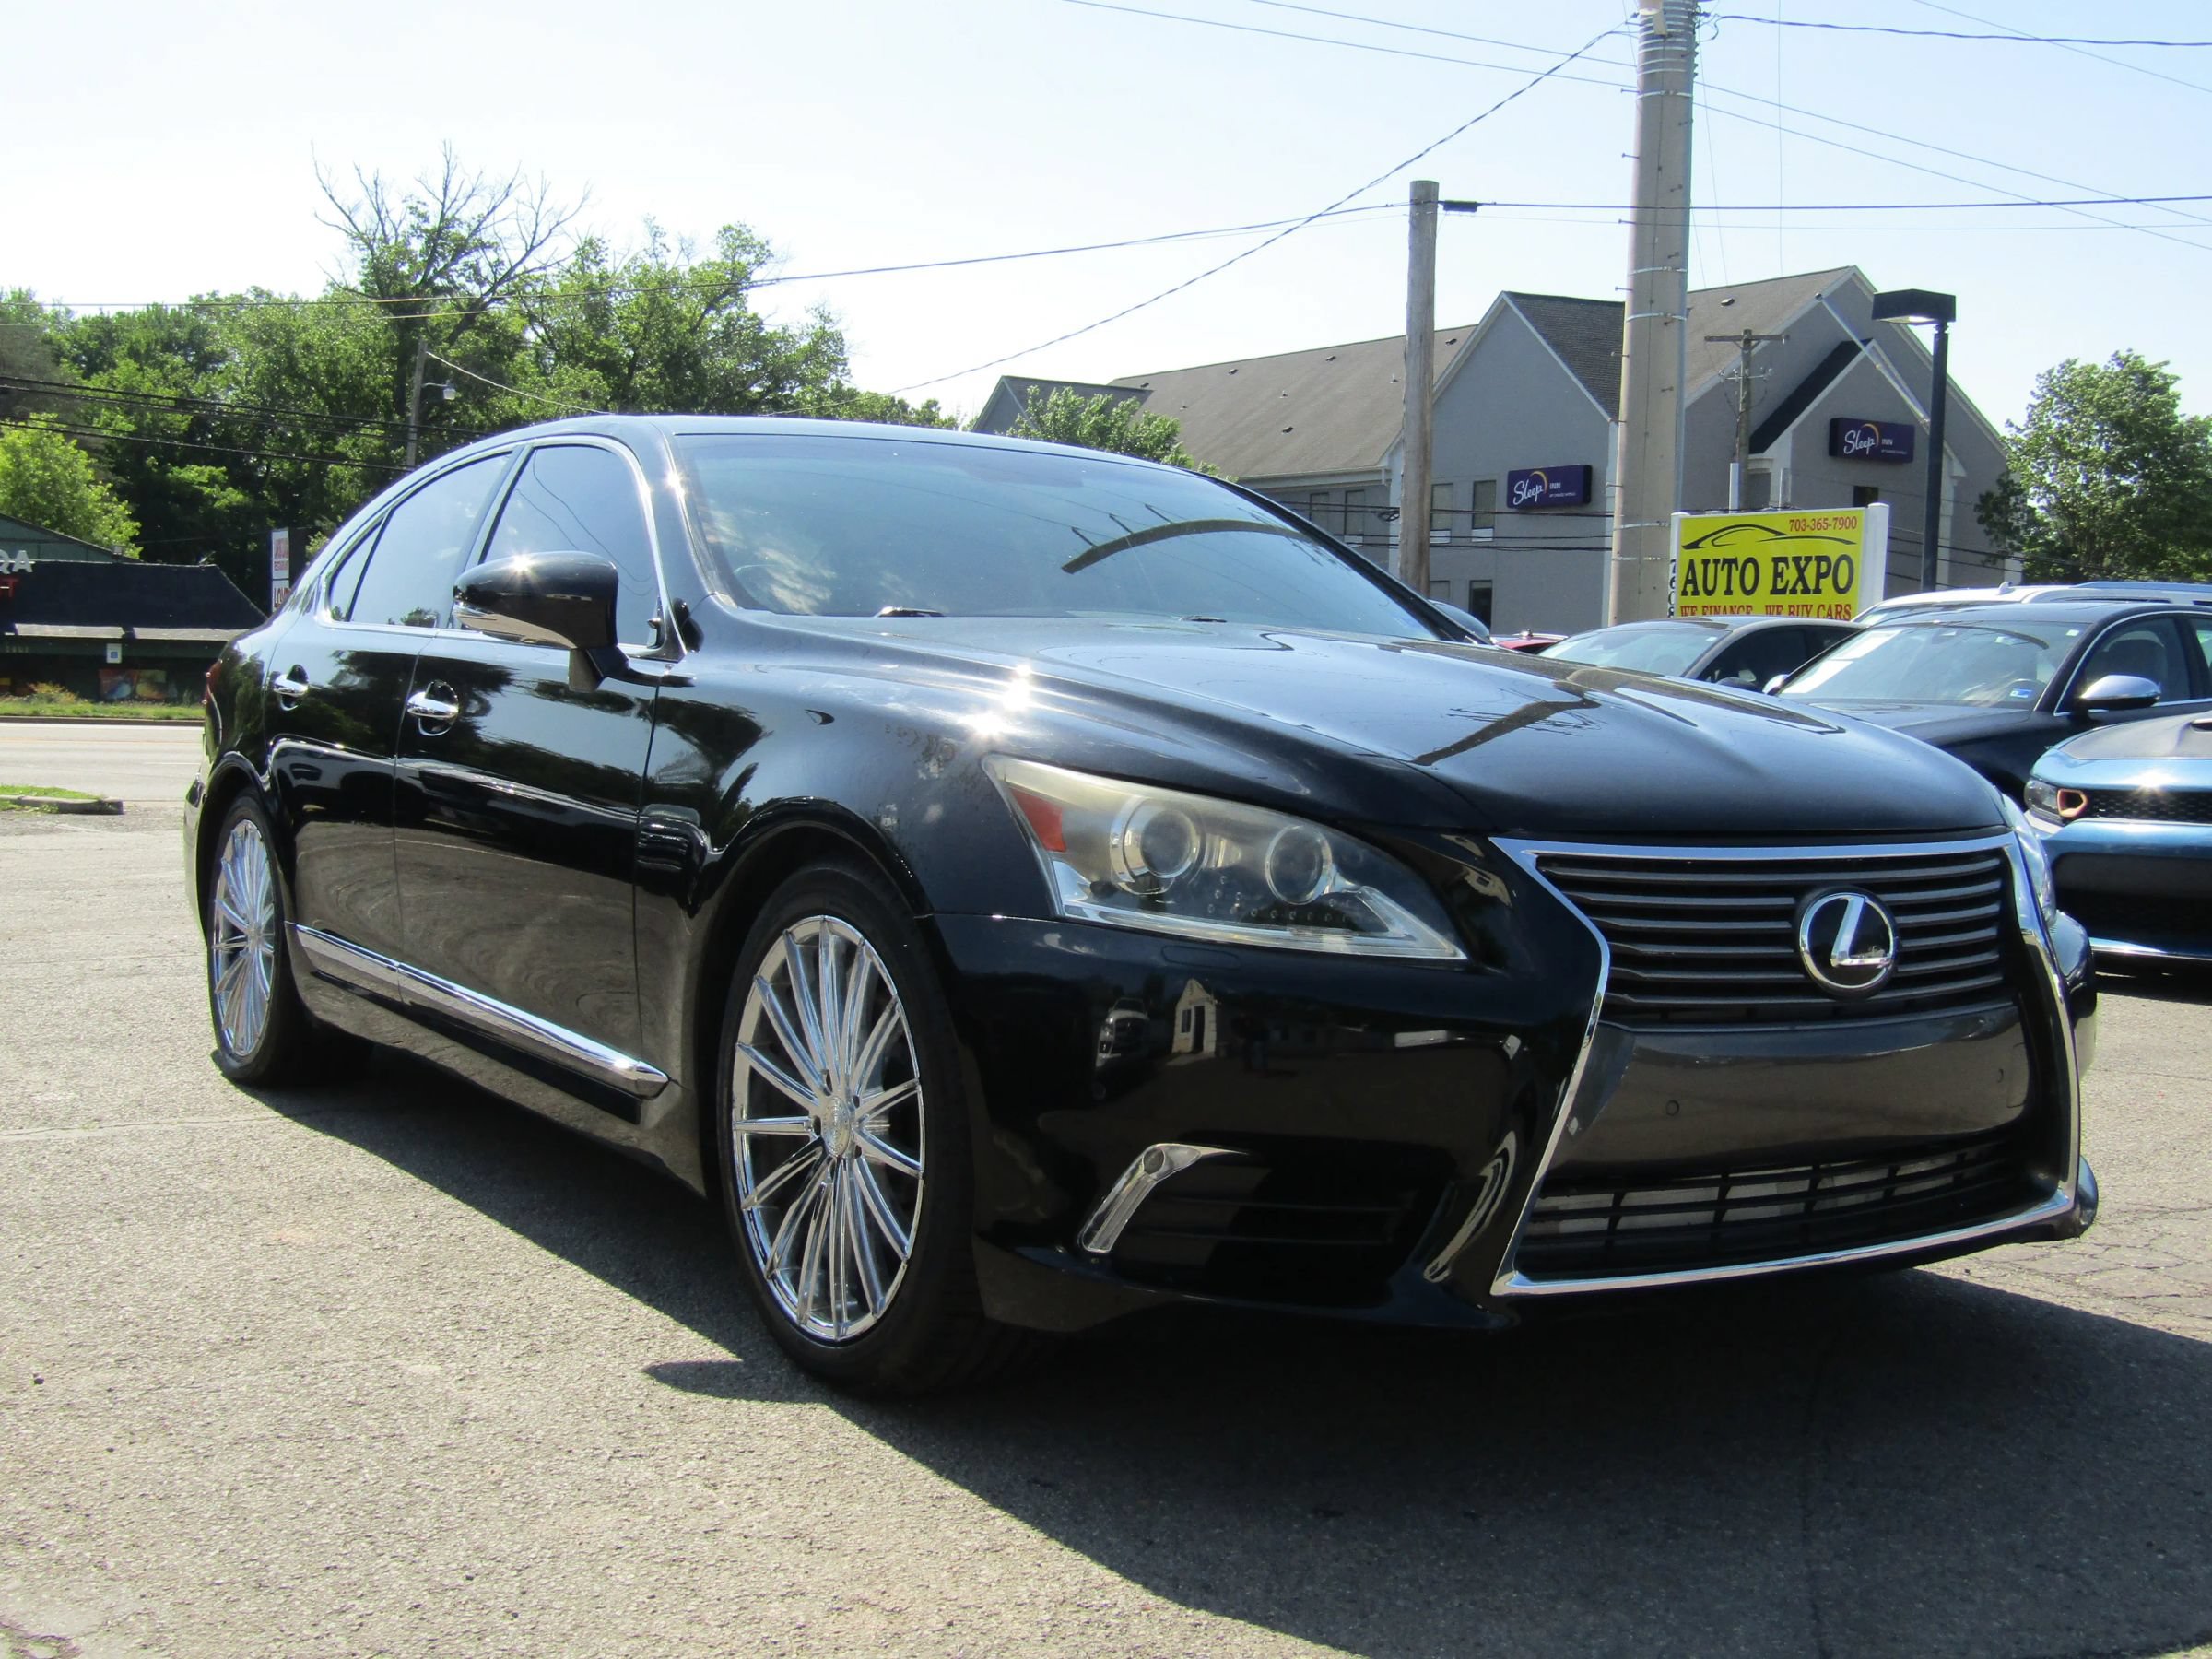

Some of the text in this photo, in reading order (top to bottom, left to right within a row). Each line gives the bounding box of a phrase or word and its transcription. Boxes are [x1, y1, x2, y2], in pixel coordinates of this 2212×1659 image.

[1843, 429, 1876, 455] Sleep
[1512, 478, 1544, 505] Sleep
[1788, 515, 1858, 532] 703-365-7900
[1680, 554, 1854, 597] AUTO EXPO
[1680, 604, 1852, 620] WE FINANCE WE BUY CARS
